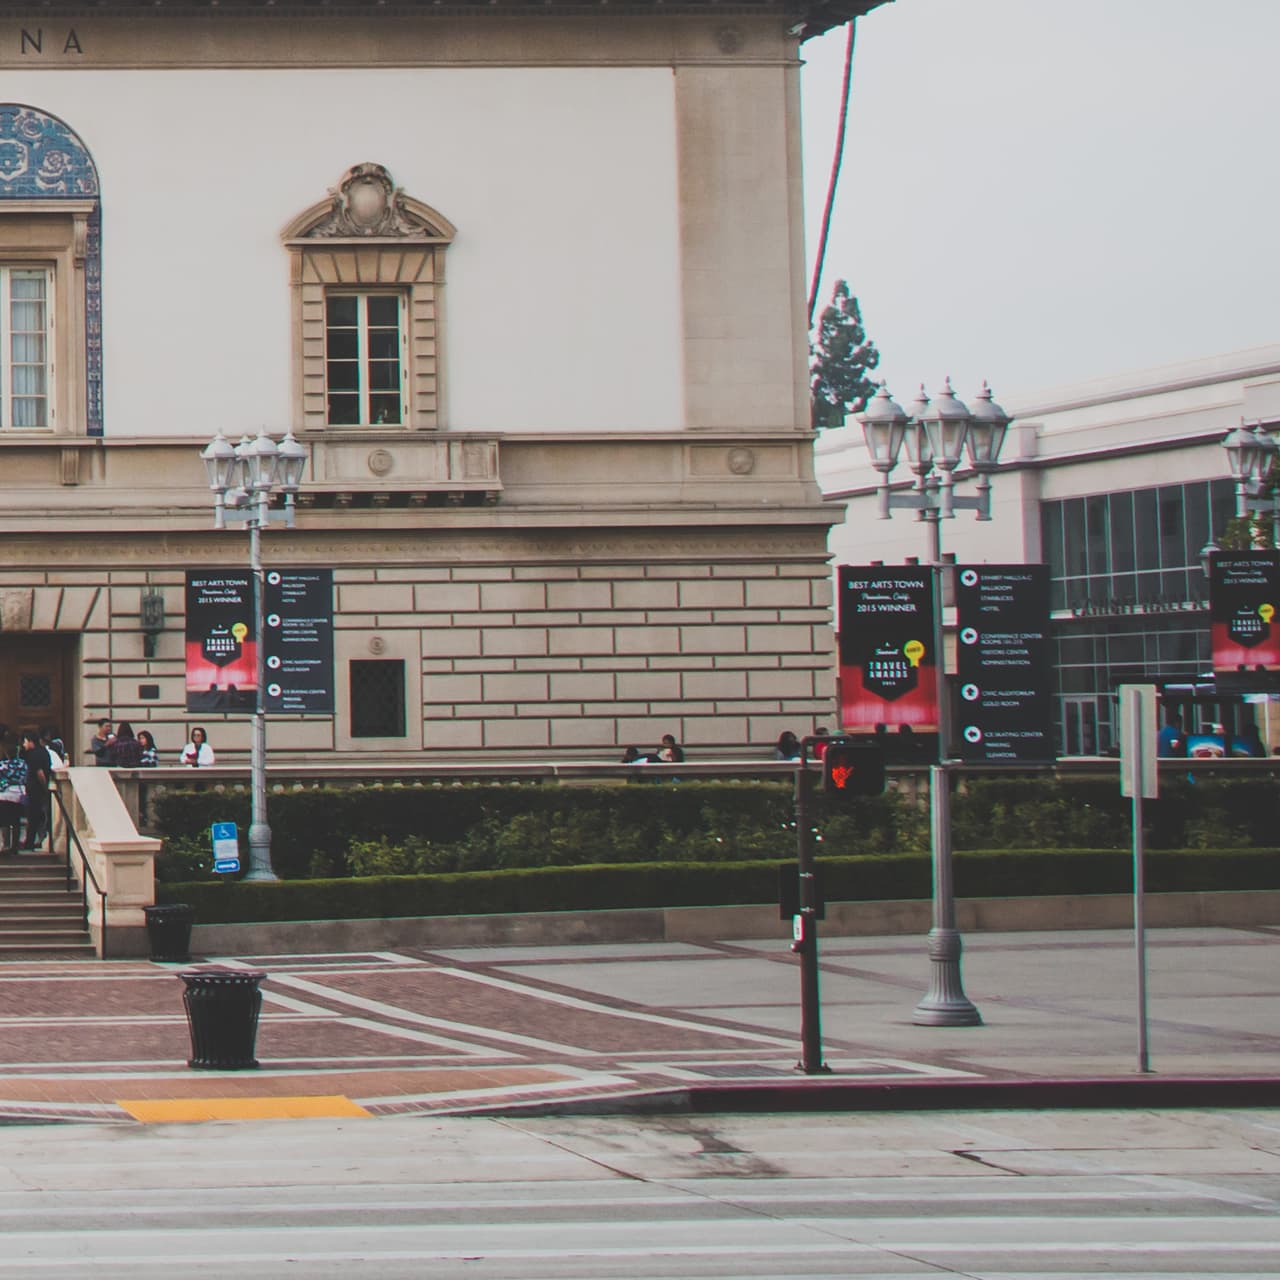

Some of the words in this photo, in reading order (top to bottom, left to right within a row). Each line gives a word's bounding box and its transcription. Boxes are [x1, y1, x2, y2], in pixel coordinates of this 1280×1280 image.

[848, 580, 869, 589] BEST
[871, 580, 893, 589] ARTS
[894, 580, 924, 589] TOWN
[856, 604, 877, 613] 2015
[877, 604, 917, 612] WINNER
[869, 661, 908, 670] TRAVEL
[869, 670, 908, 678] AWARDS
